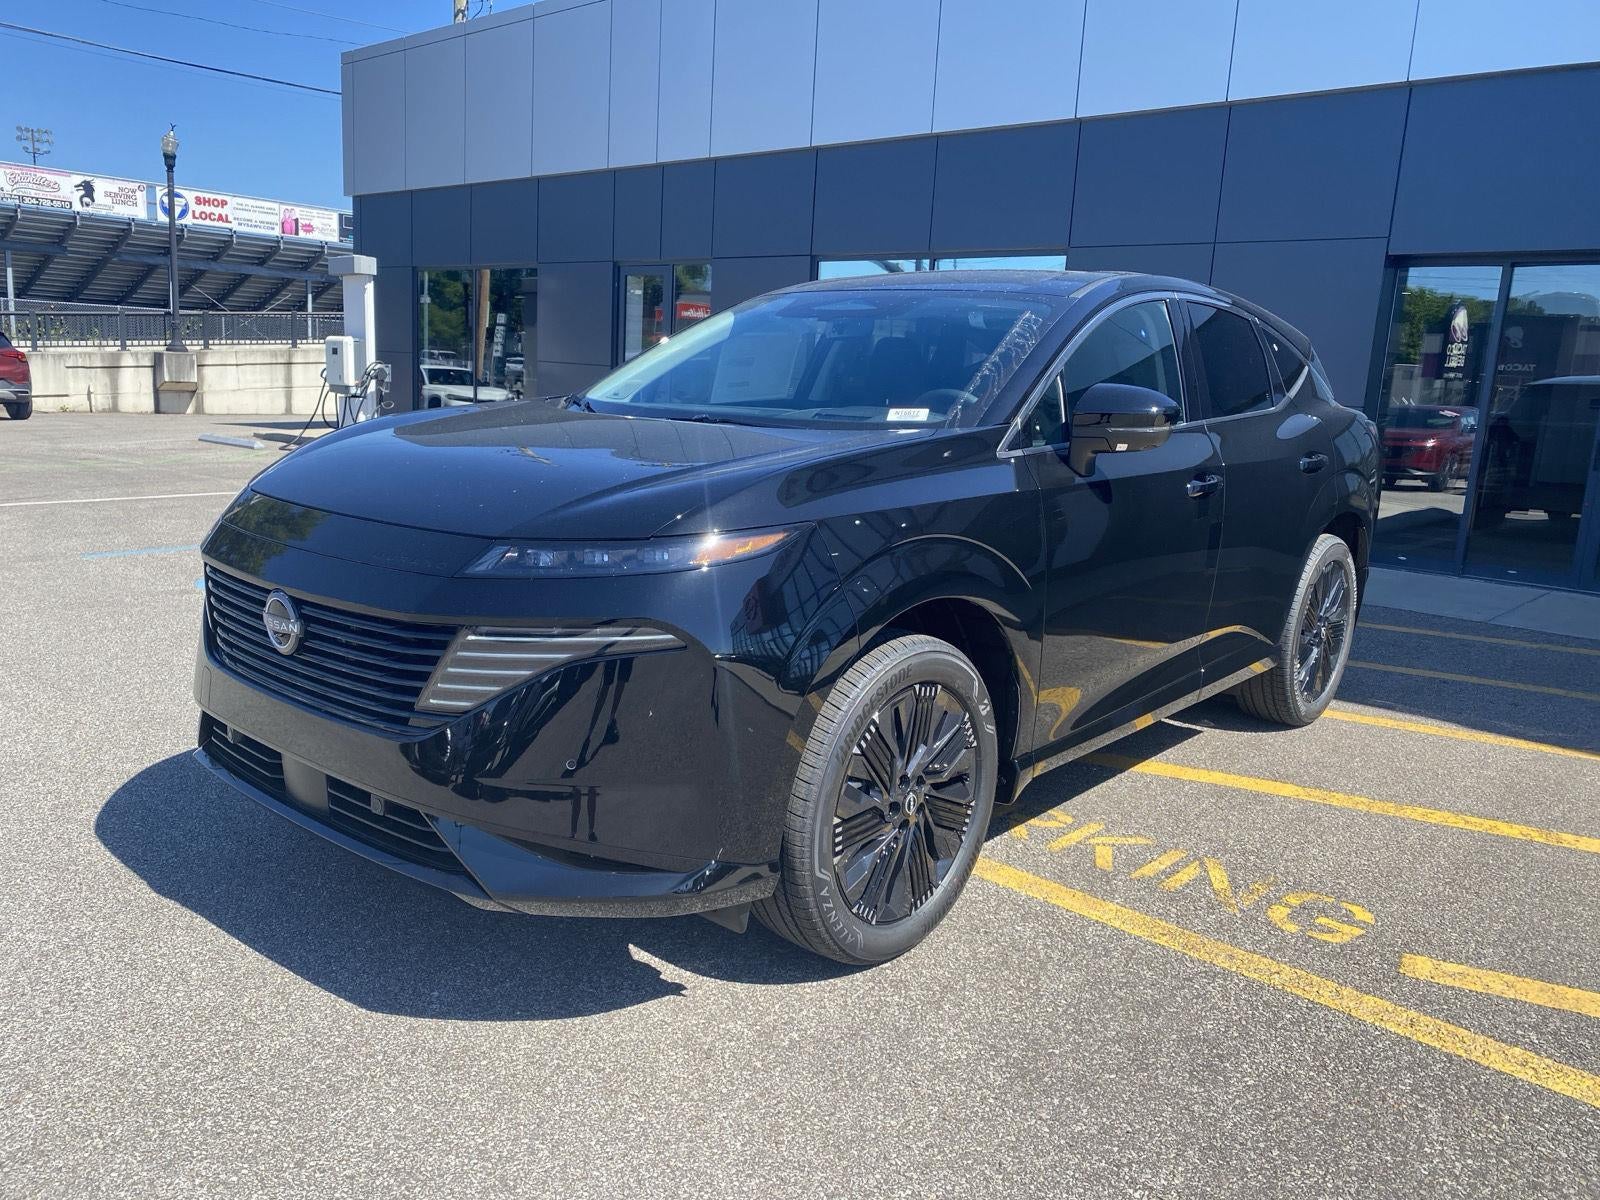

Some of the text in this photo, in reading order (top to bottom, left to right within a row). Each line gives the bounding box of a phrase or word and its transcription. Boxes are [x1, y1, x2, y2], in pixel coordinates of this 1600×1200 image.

[104, 191, 137, 201] SERVING
[118, 186, 137, 194] NOW
[112, 198, 138, 207] LUNCH
[194, 195, 228, 209] SHOP
[191, 210, 232, 223] LOCAL
[265, 616, 298, 633] SSAN
[820, 885, 857, 945] ALENZA
